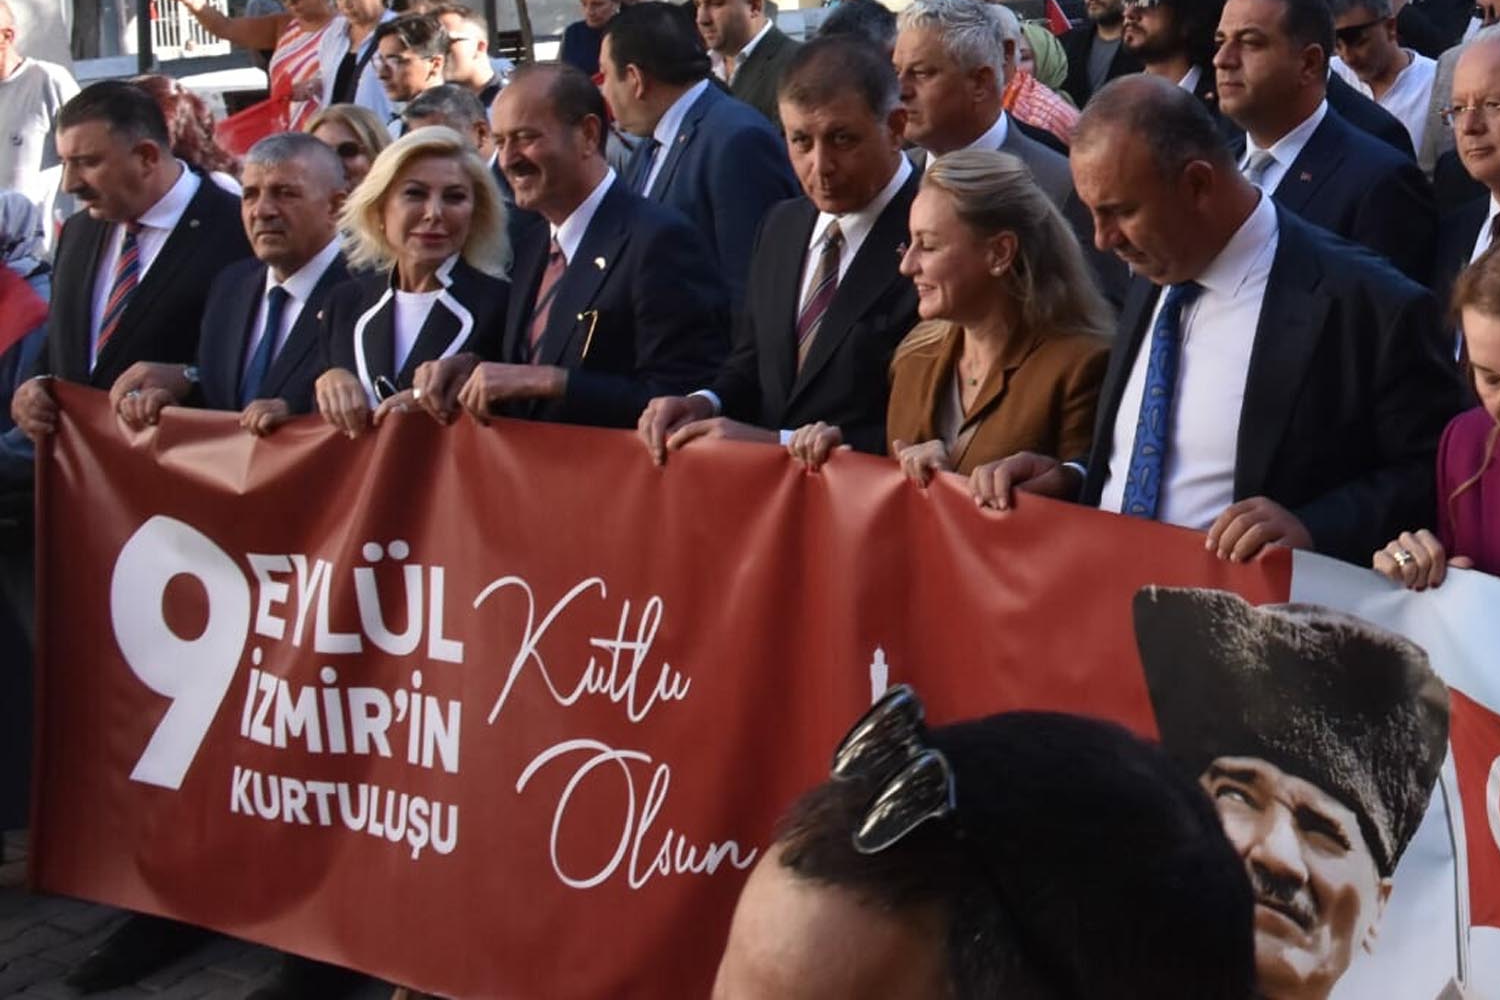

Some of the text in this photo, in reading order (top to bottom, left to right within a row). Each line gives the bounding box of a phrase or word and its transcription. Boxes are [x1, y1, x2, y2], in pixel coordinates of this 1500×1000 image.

[111, 515, 465, 790] 9 EYLÜL
[472, 575, 691, 725] Kutlu
[231, 765, 458, 860] KURTULUŞU
[515, 738, 759, 891] Olsun
